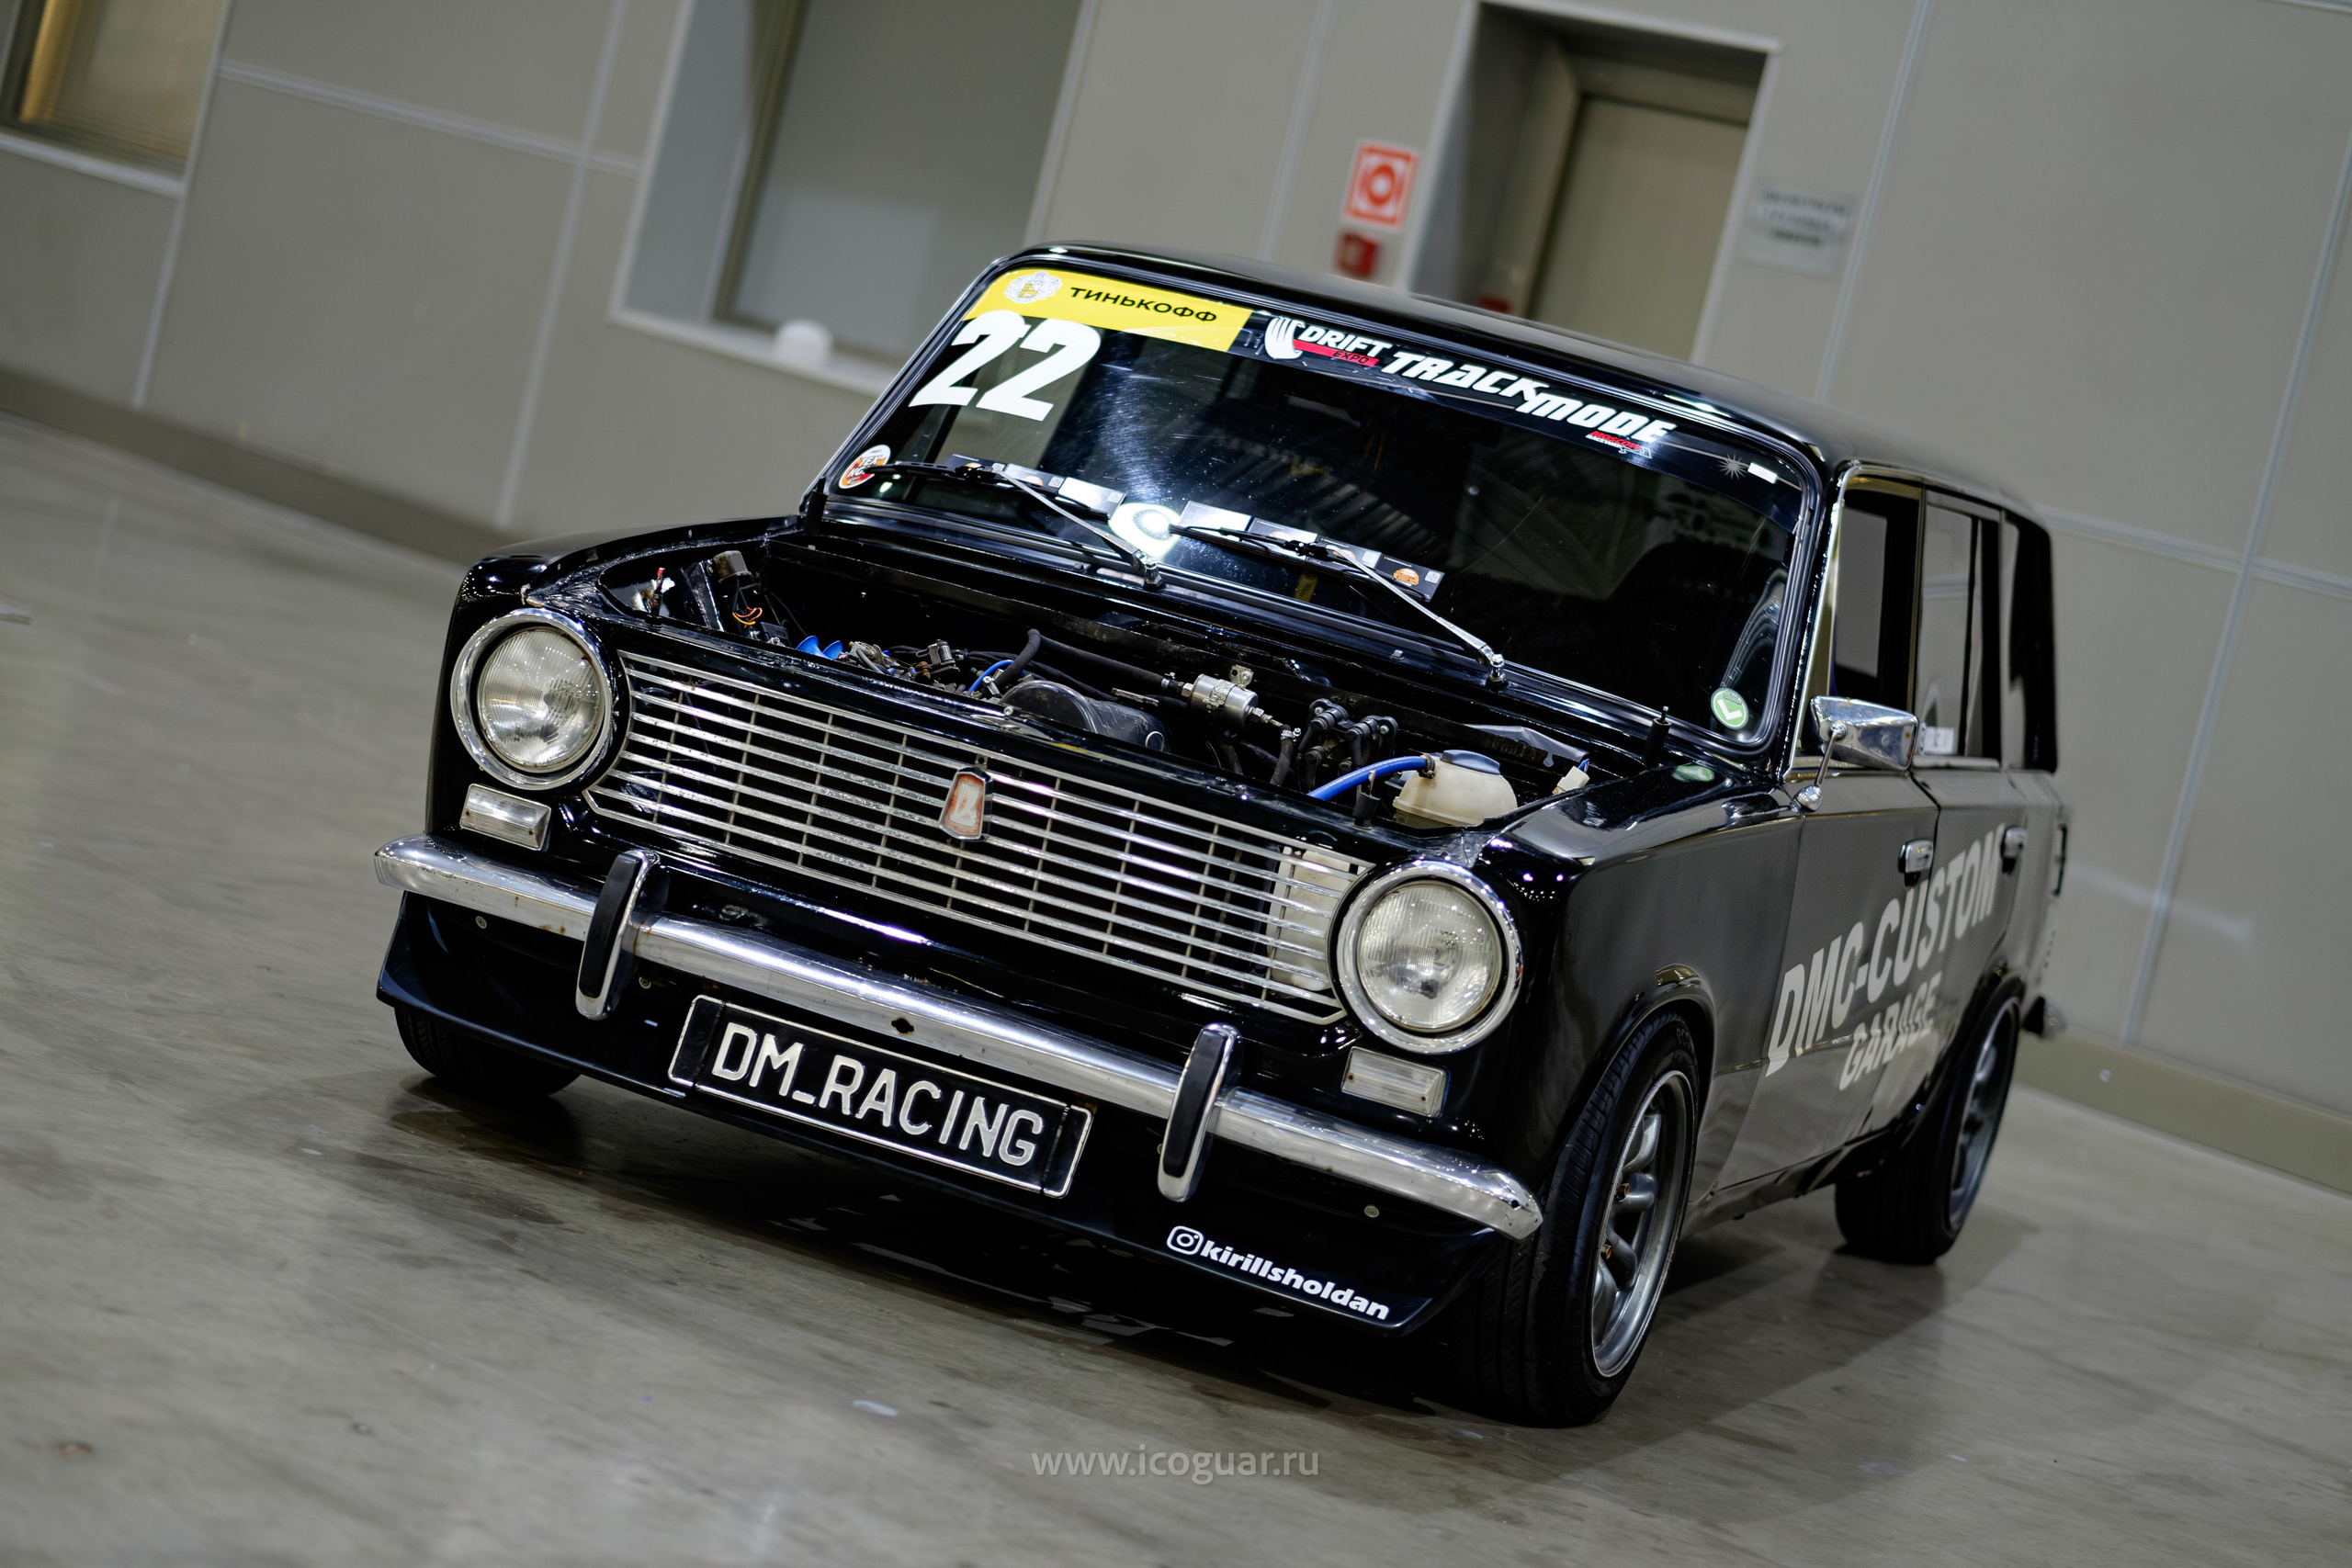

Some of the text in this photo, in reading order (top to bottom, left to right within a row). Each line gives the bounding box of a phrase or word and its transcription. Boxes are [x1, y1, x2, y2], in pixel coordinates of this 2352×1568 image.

[1070, 287, 1217, 321] ТИНЬКОФФ
[1297, 325, 1393, 357] DRIFT
[908, 310, 1102, 422] 22
[1332, 349, 1370, 365] EXPO
[1765, 822, 2006, 1077] DMC-CUSTOM
[1839, 971, 1942, 1091] GARAGE
[711, 1021, 1045, 1168] DM_RACING
[1199, 1239, 1390, 1321] kirillsholdan
